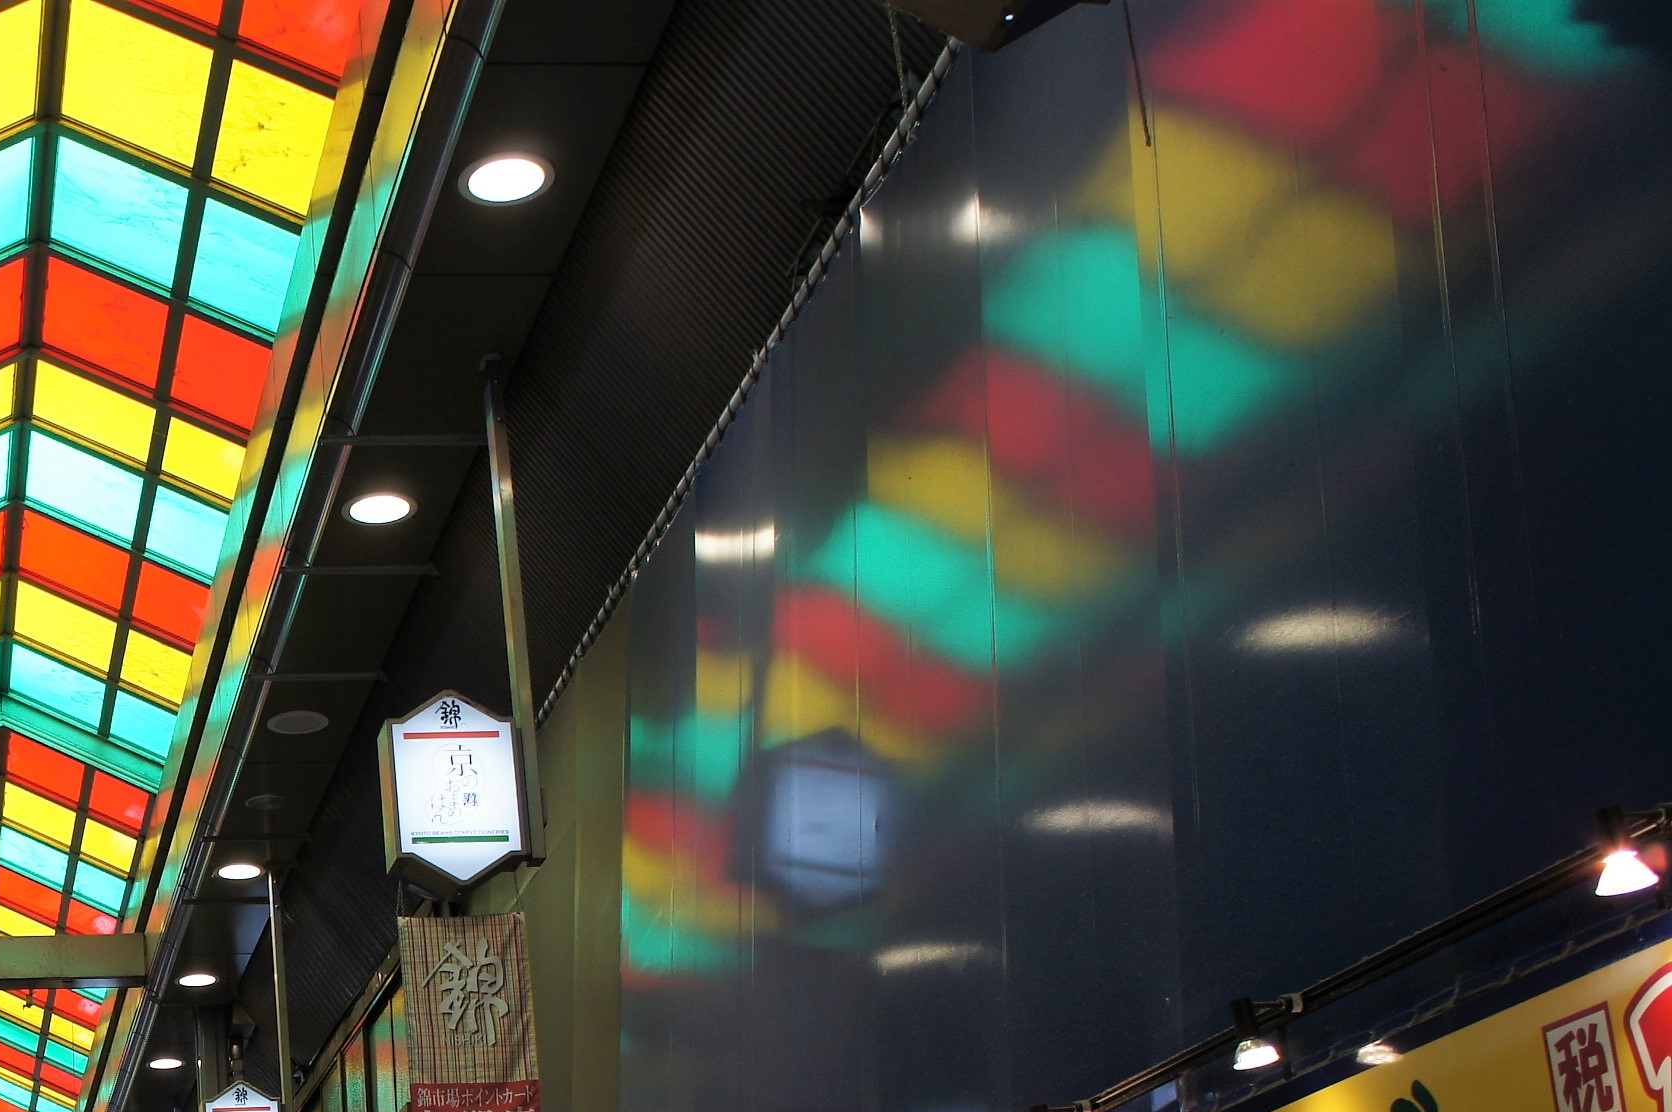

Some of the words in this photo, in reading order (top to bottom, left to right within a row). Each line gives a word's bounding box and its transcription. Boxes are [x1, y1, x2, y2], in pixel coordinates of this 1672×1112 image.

[435, 699, 462, 729] 錦
[422, 938, 509, 1046] 錦
[417, 1085, 534, 1108] 錦市場ポイントカード
